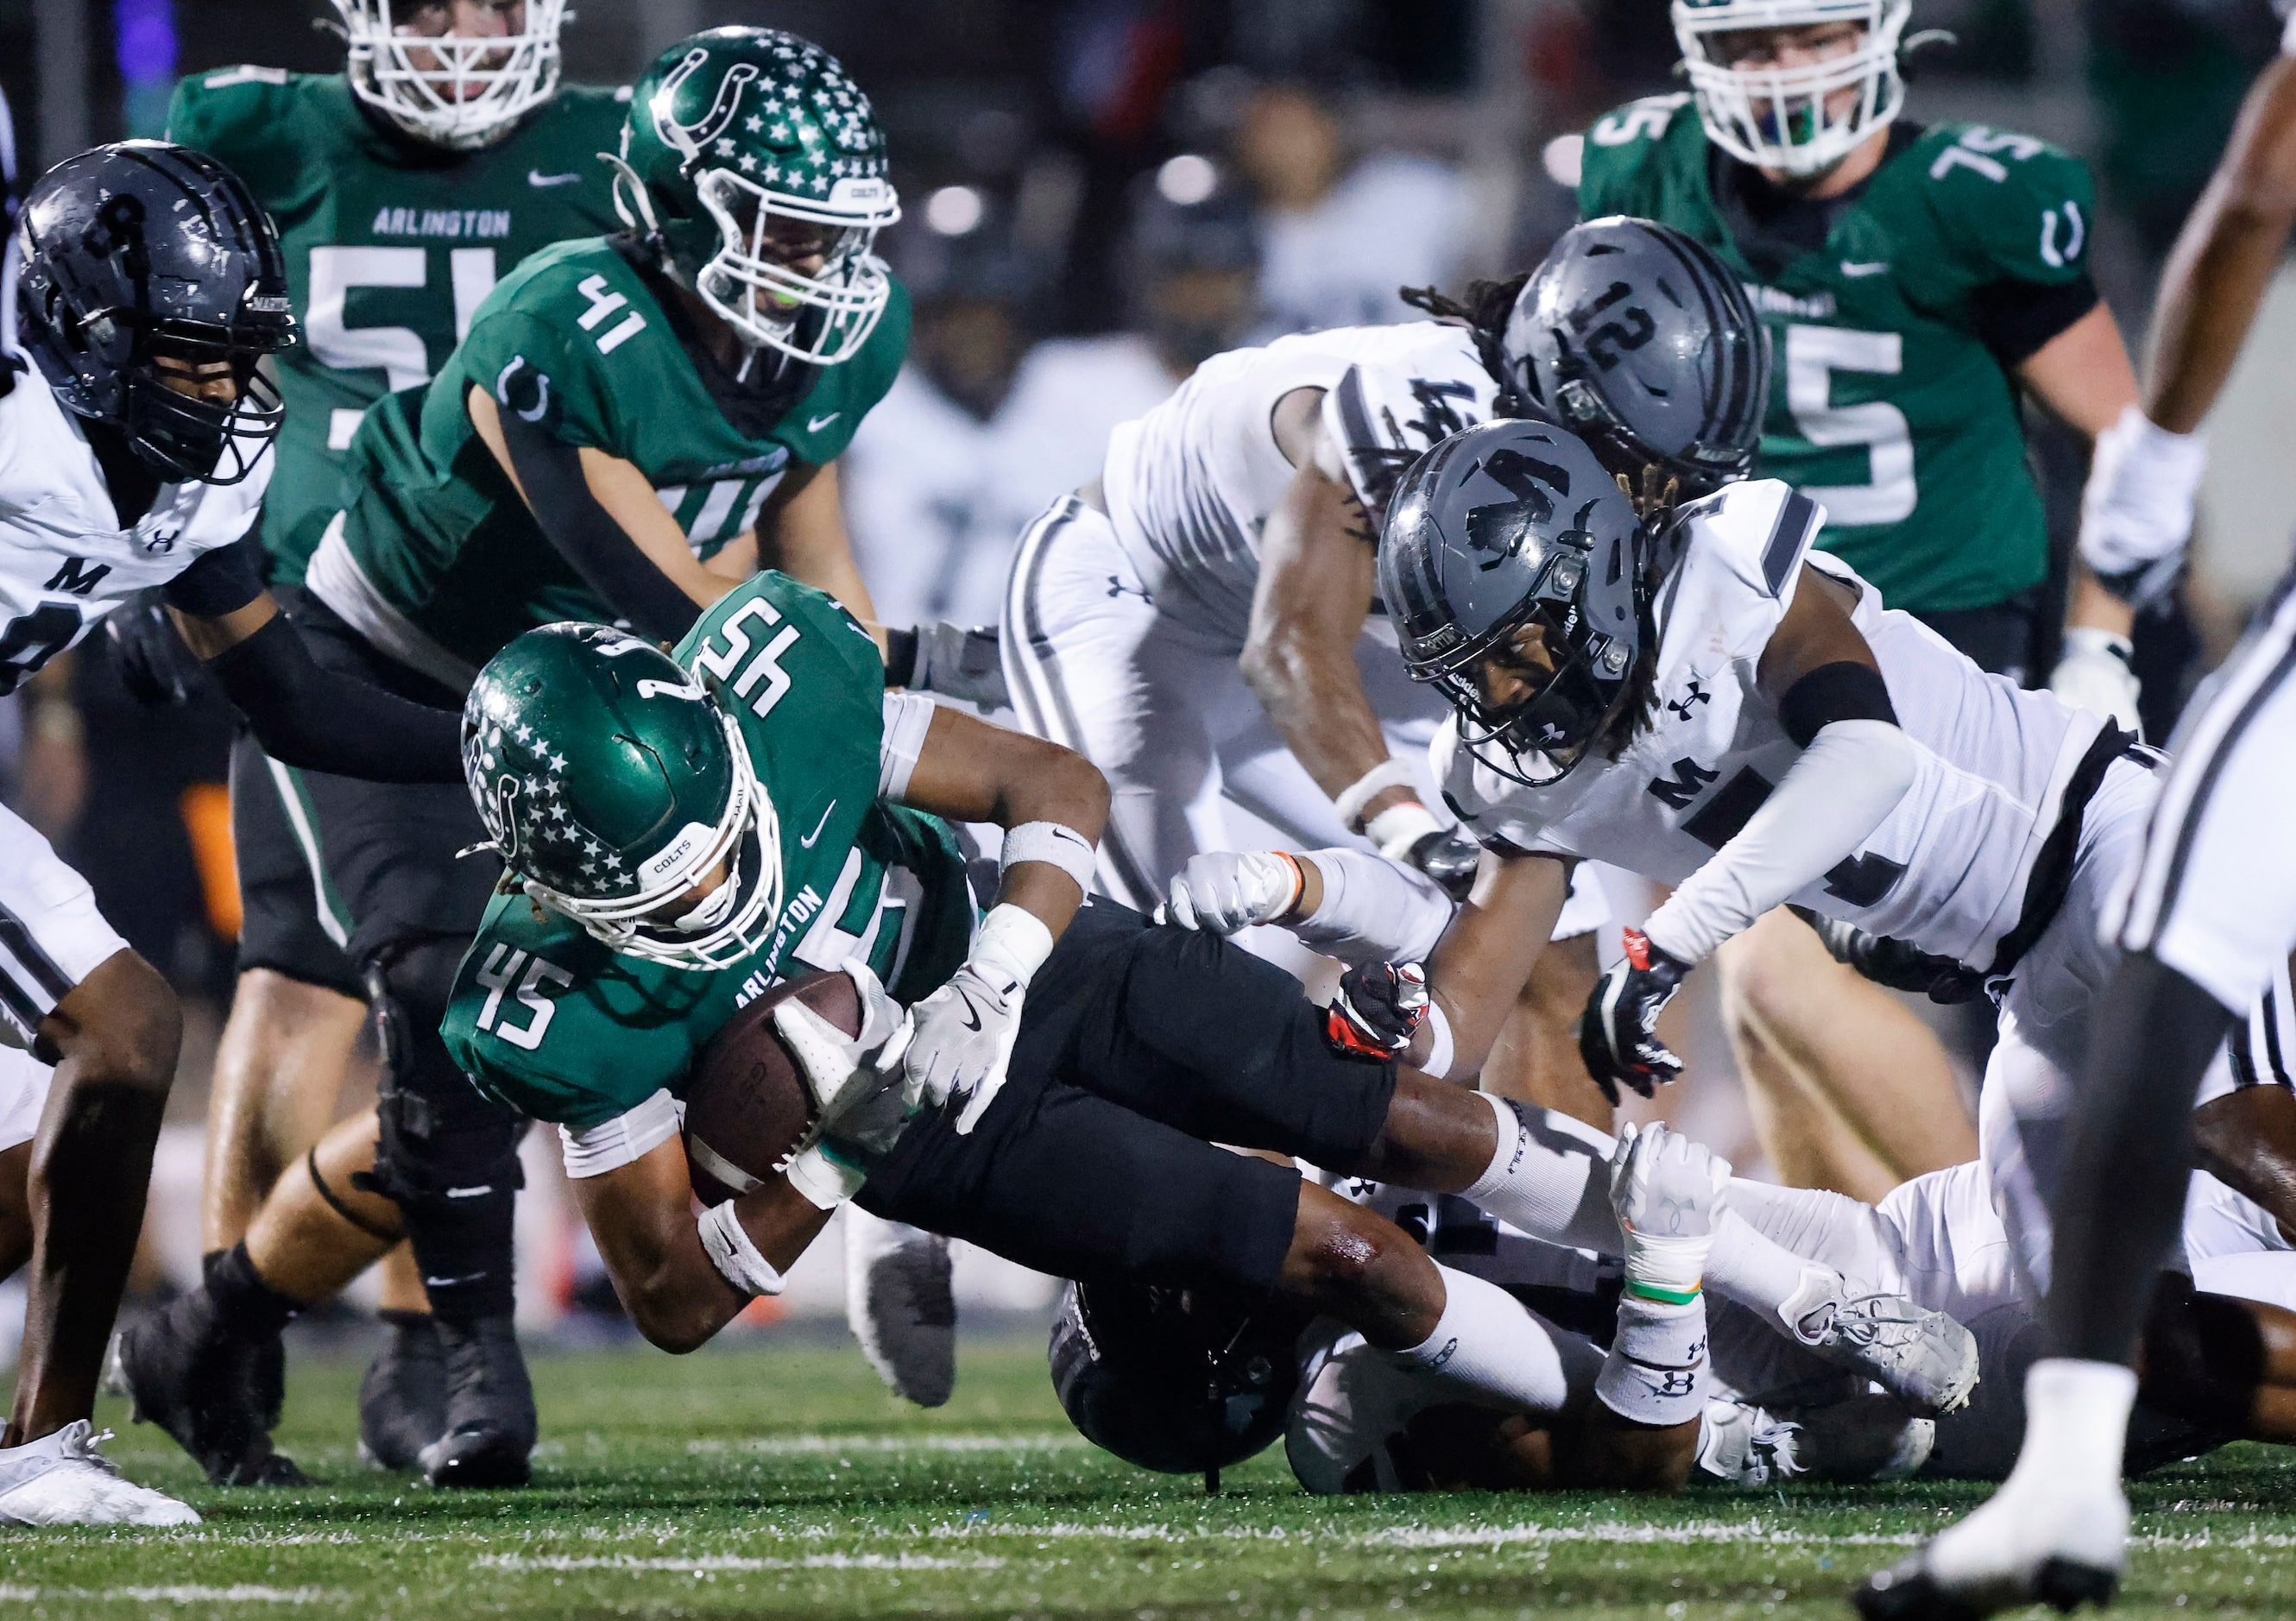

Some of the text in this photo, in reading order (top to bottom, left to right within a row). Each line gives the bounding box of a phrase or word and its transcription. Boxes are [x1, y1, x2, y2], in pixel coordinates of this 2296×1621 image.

[1930, 126, 2046, 184] 75
[372, 206, 511, 237] ARLINGTON
[577, 274, 647, 355] 41
[1567, 281, 1656, 375] 12
[1757, 323, 1918, 527] 5
[44, 557, 112, 595] M
[701, 596, 802, 719] 45
[1647, 756, 1721, 810] M
[653, 840, 691, 874] COLTS
[735, 884, 823, 1009] ARLINGTON
[476, 942, 575, 1050] 45
